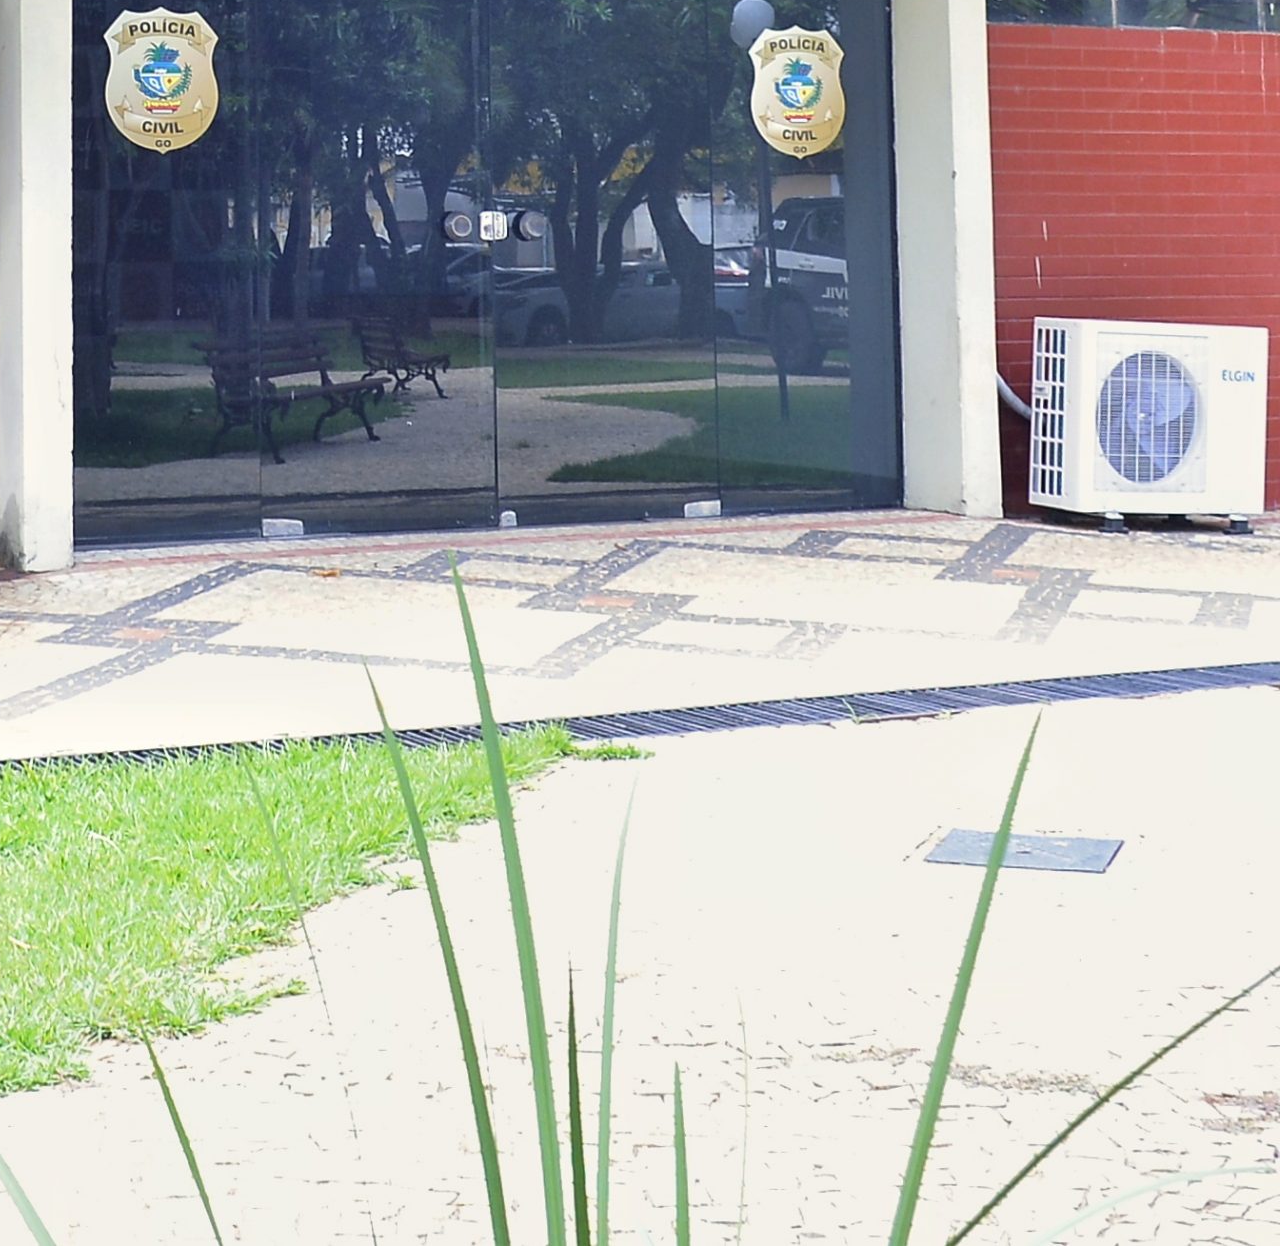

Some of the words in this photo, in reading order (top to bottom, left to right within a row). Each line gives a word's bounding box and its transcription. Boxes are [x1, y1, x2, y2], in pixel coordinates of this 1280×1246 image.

[128, 18, 196, 37] POLÍCIA
[769, 36, 826, 53] POLÍCIA
[142, 120, 184, 134] CIVIL
[782, 129, 818, 141] CIVIL
[155, 139, 171, 148] GO
[793, 146, 807, 154] GO
[1222, 369, 1255, 382] ELGIN
